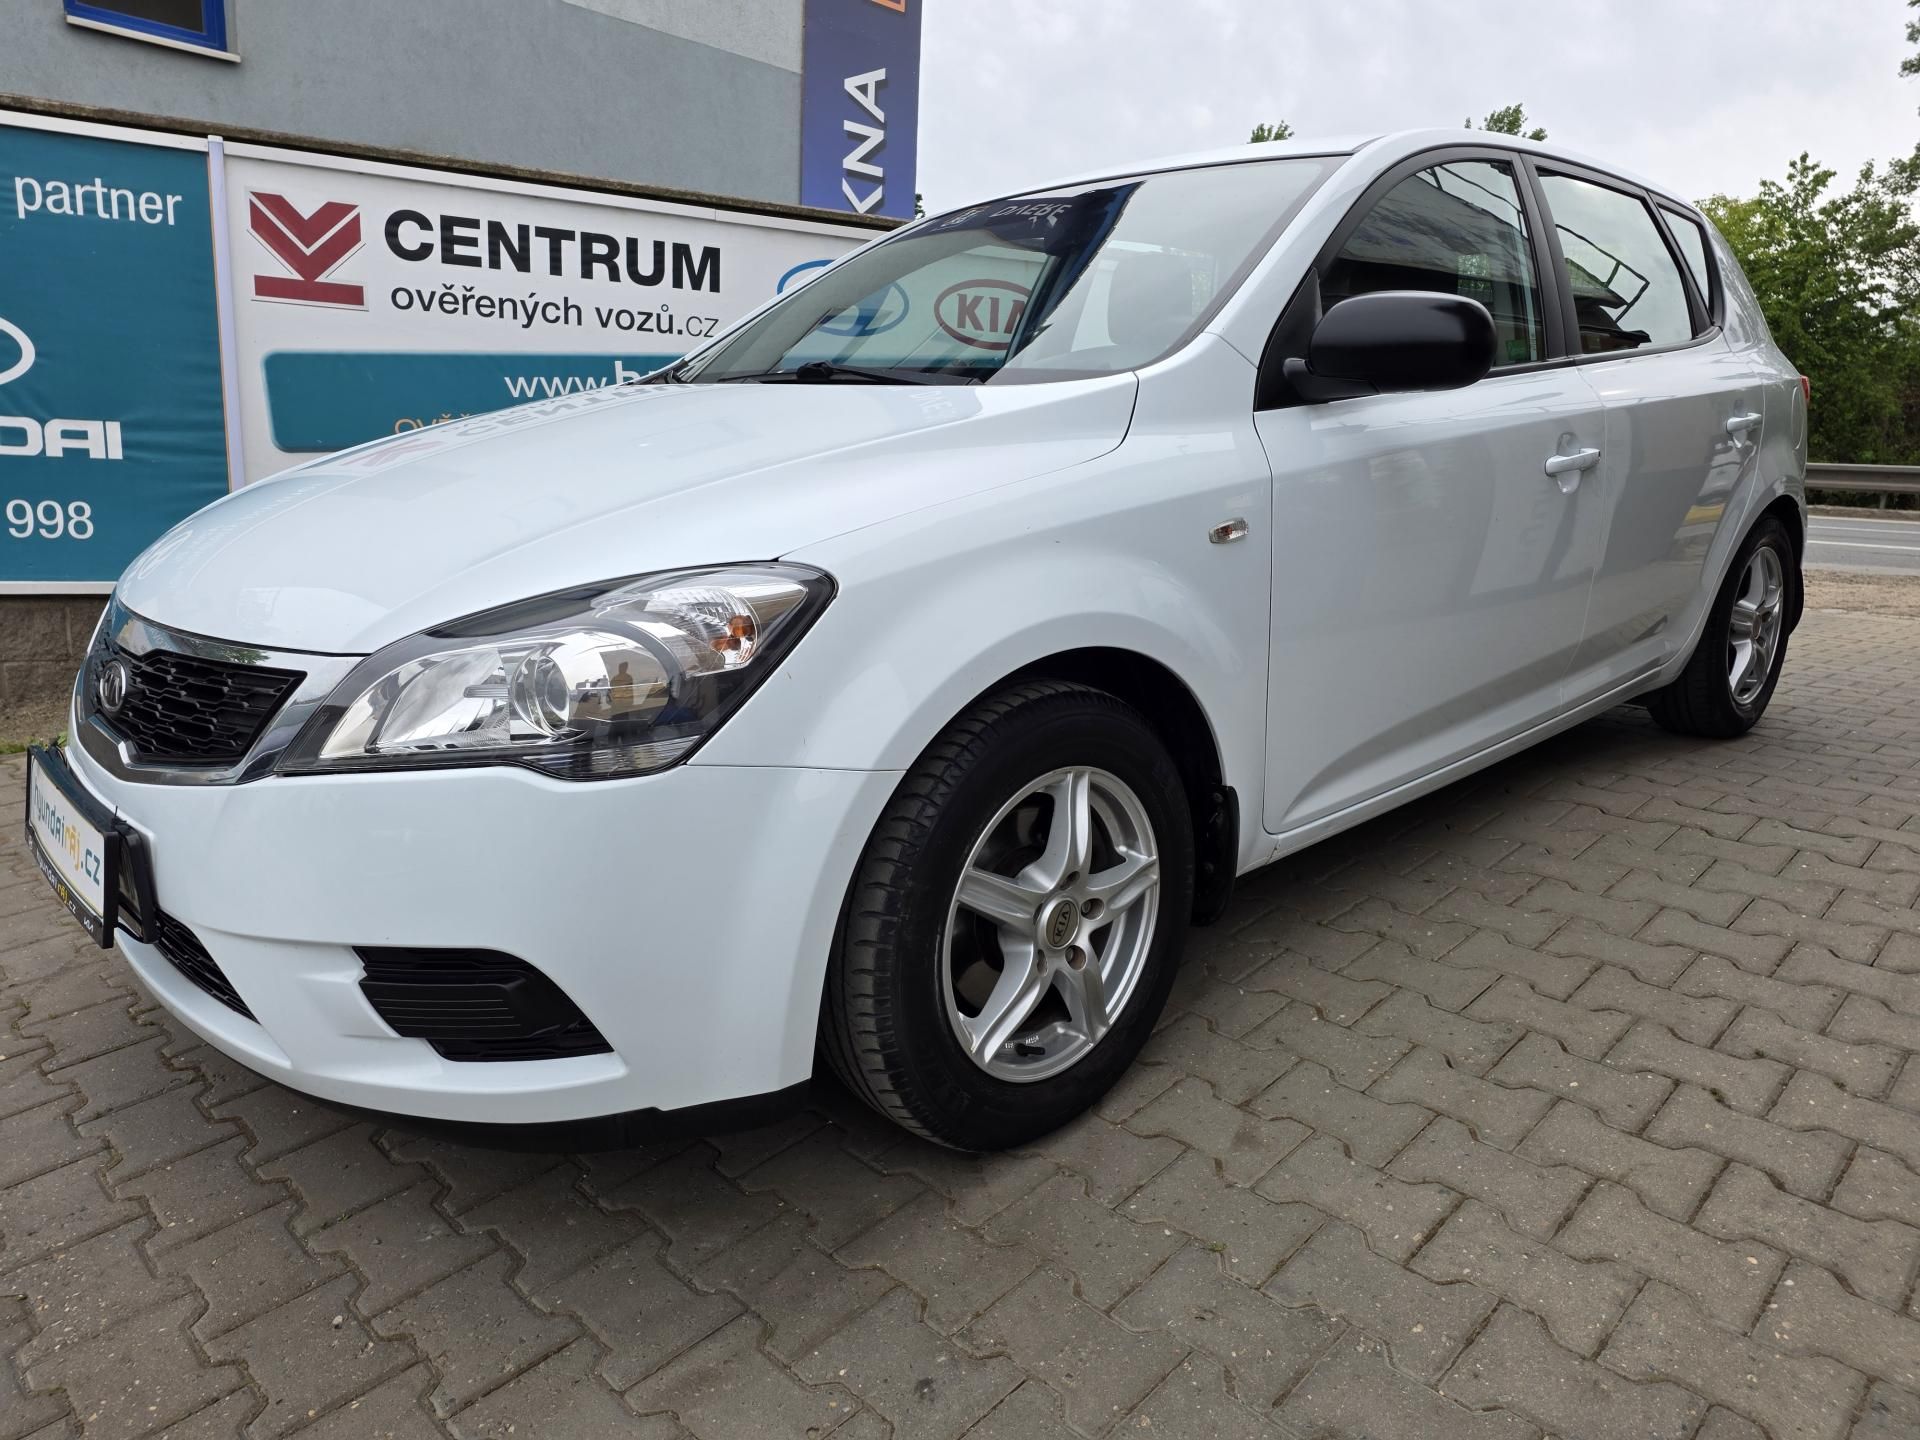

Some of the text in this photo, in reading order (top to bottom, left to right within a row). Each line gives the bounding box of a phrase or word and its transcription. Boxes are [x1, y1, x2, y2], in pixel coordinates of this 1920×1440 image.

[14, 176, 183, 226] partner
[383, 208, 722, 293] CENTRUM
[390, 283, 720, 338] ověřených vozů.cz
[5, 499, 95, 540] 998
[1054, 911, 1070, 937] KIA
